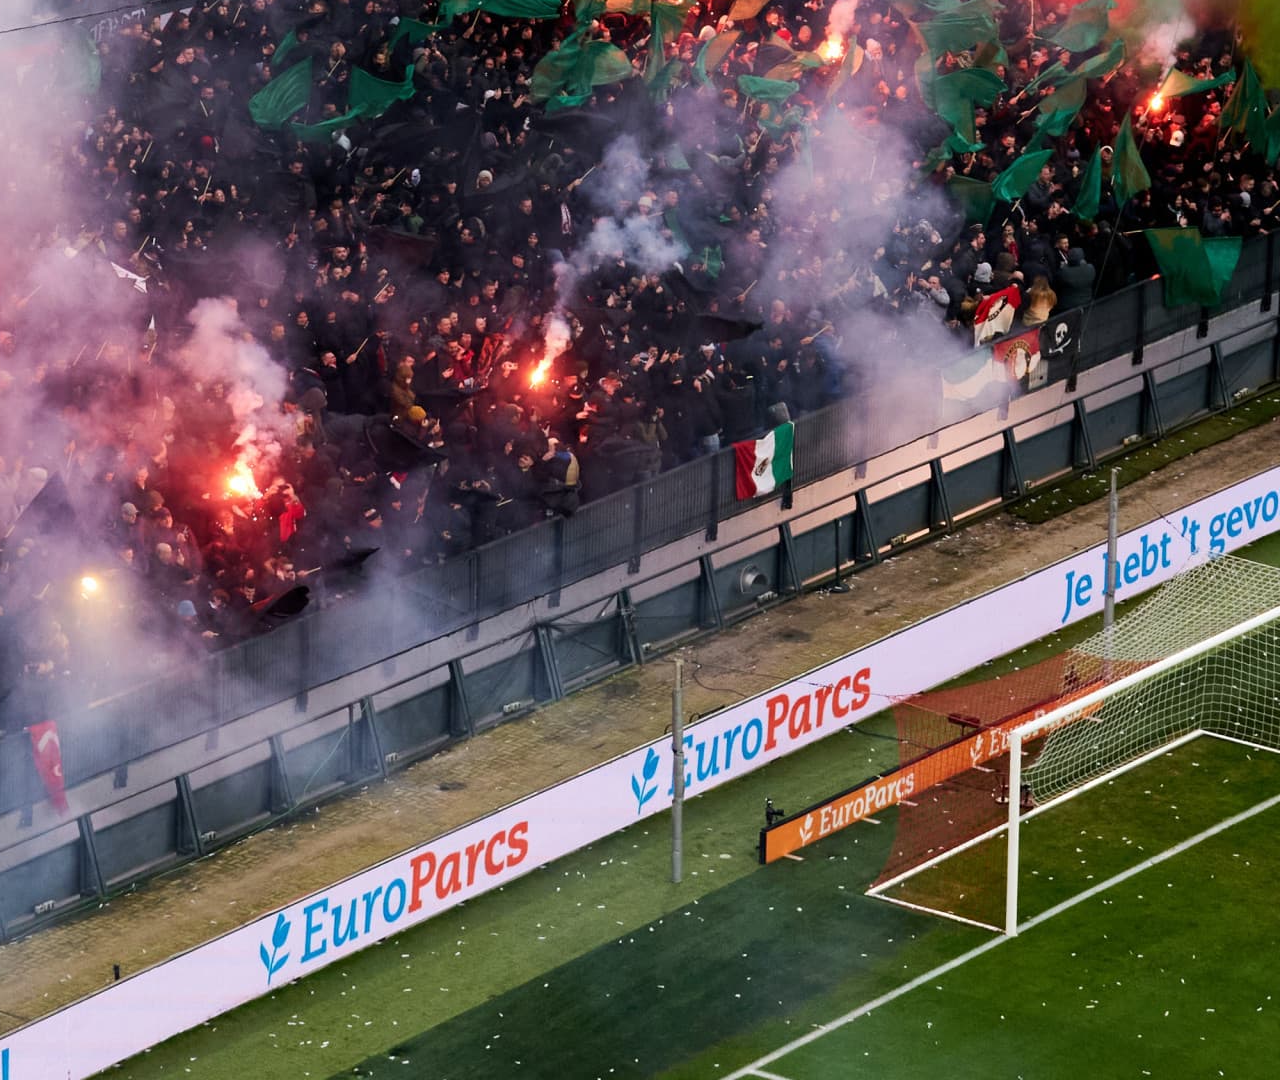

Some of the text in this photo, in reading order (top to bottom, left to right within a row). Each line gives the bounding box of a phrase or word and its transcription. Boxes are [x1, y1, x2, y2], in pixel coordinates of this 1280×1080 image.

[1062, 571, 1093, 624] Je
[1102, 533, 1172, 596] hebt
[818, 772, 915, 836] EuroParcs
[300, 821, 528, 964] EuroParcs
